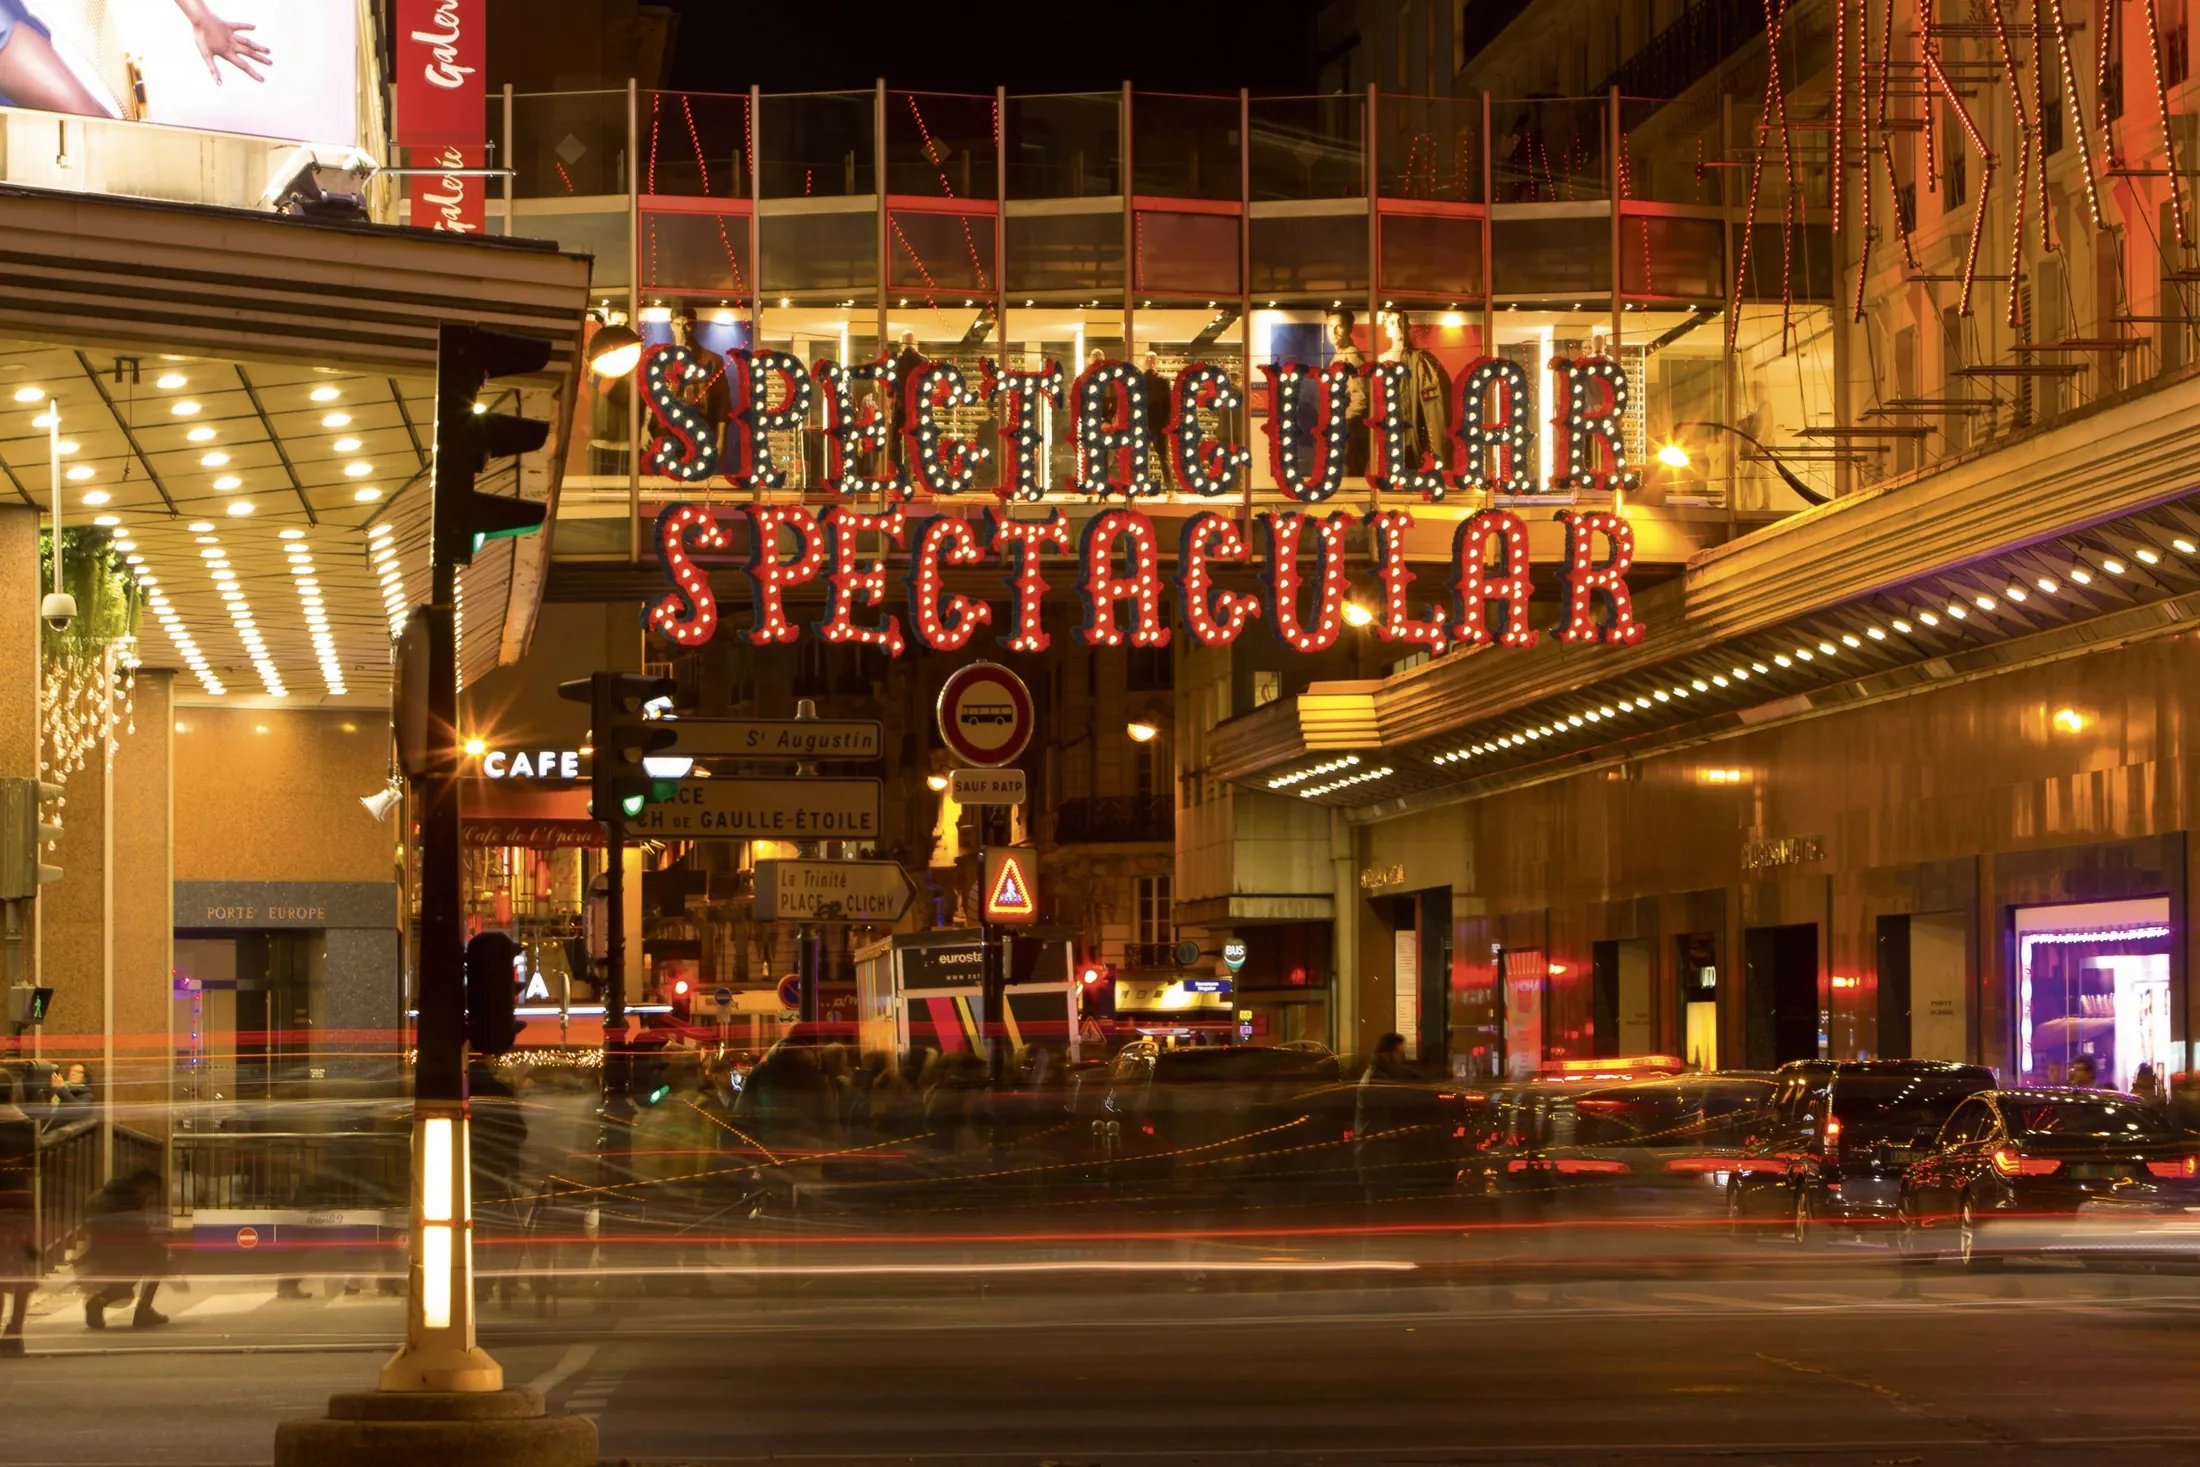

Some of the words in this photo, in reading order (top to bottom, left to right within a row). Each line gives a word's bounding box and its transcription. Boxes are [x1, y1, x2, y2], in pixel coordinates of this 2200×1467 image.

[411, 0, 476, 89] Galer
[637, 343, 1642, 501] SPECTACULAR
[640, 501, 1647, 658] SPECTACULAR
[746, 729, 766, 747] St
[777, 730, 873, 752] Augustin
[483, 751, 580, 778] CAFE
[955, 781, 987, 792] SAUF
[992, 781, 1023, 792] RATP
[701, 809, 872, 829] GAULLE-ÉTOILE
[462, 826, 500, 846] Café
[506, 827, 523, 841] de
[781, 869, 796, 887] La
[804, 869, 847, 889] Trinité
[207, 907, 254, 920] PORTE
[268, 907, 325, 920] EUROPE
[781, 893, 823, 911] PLACE
[846, 895, 895, 914] CLICHY
[938, 951, 983, 964] eurosta
[1225, 945, 1245, 956] BUS
